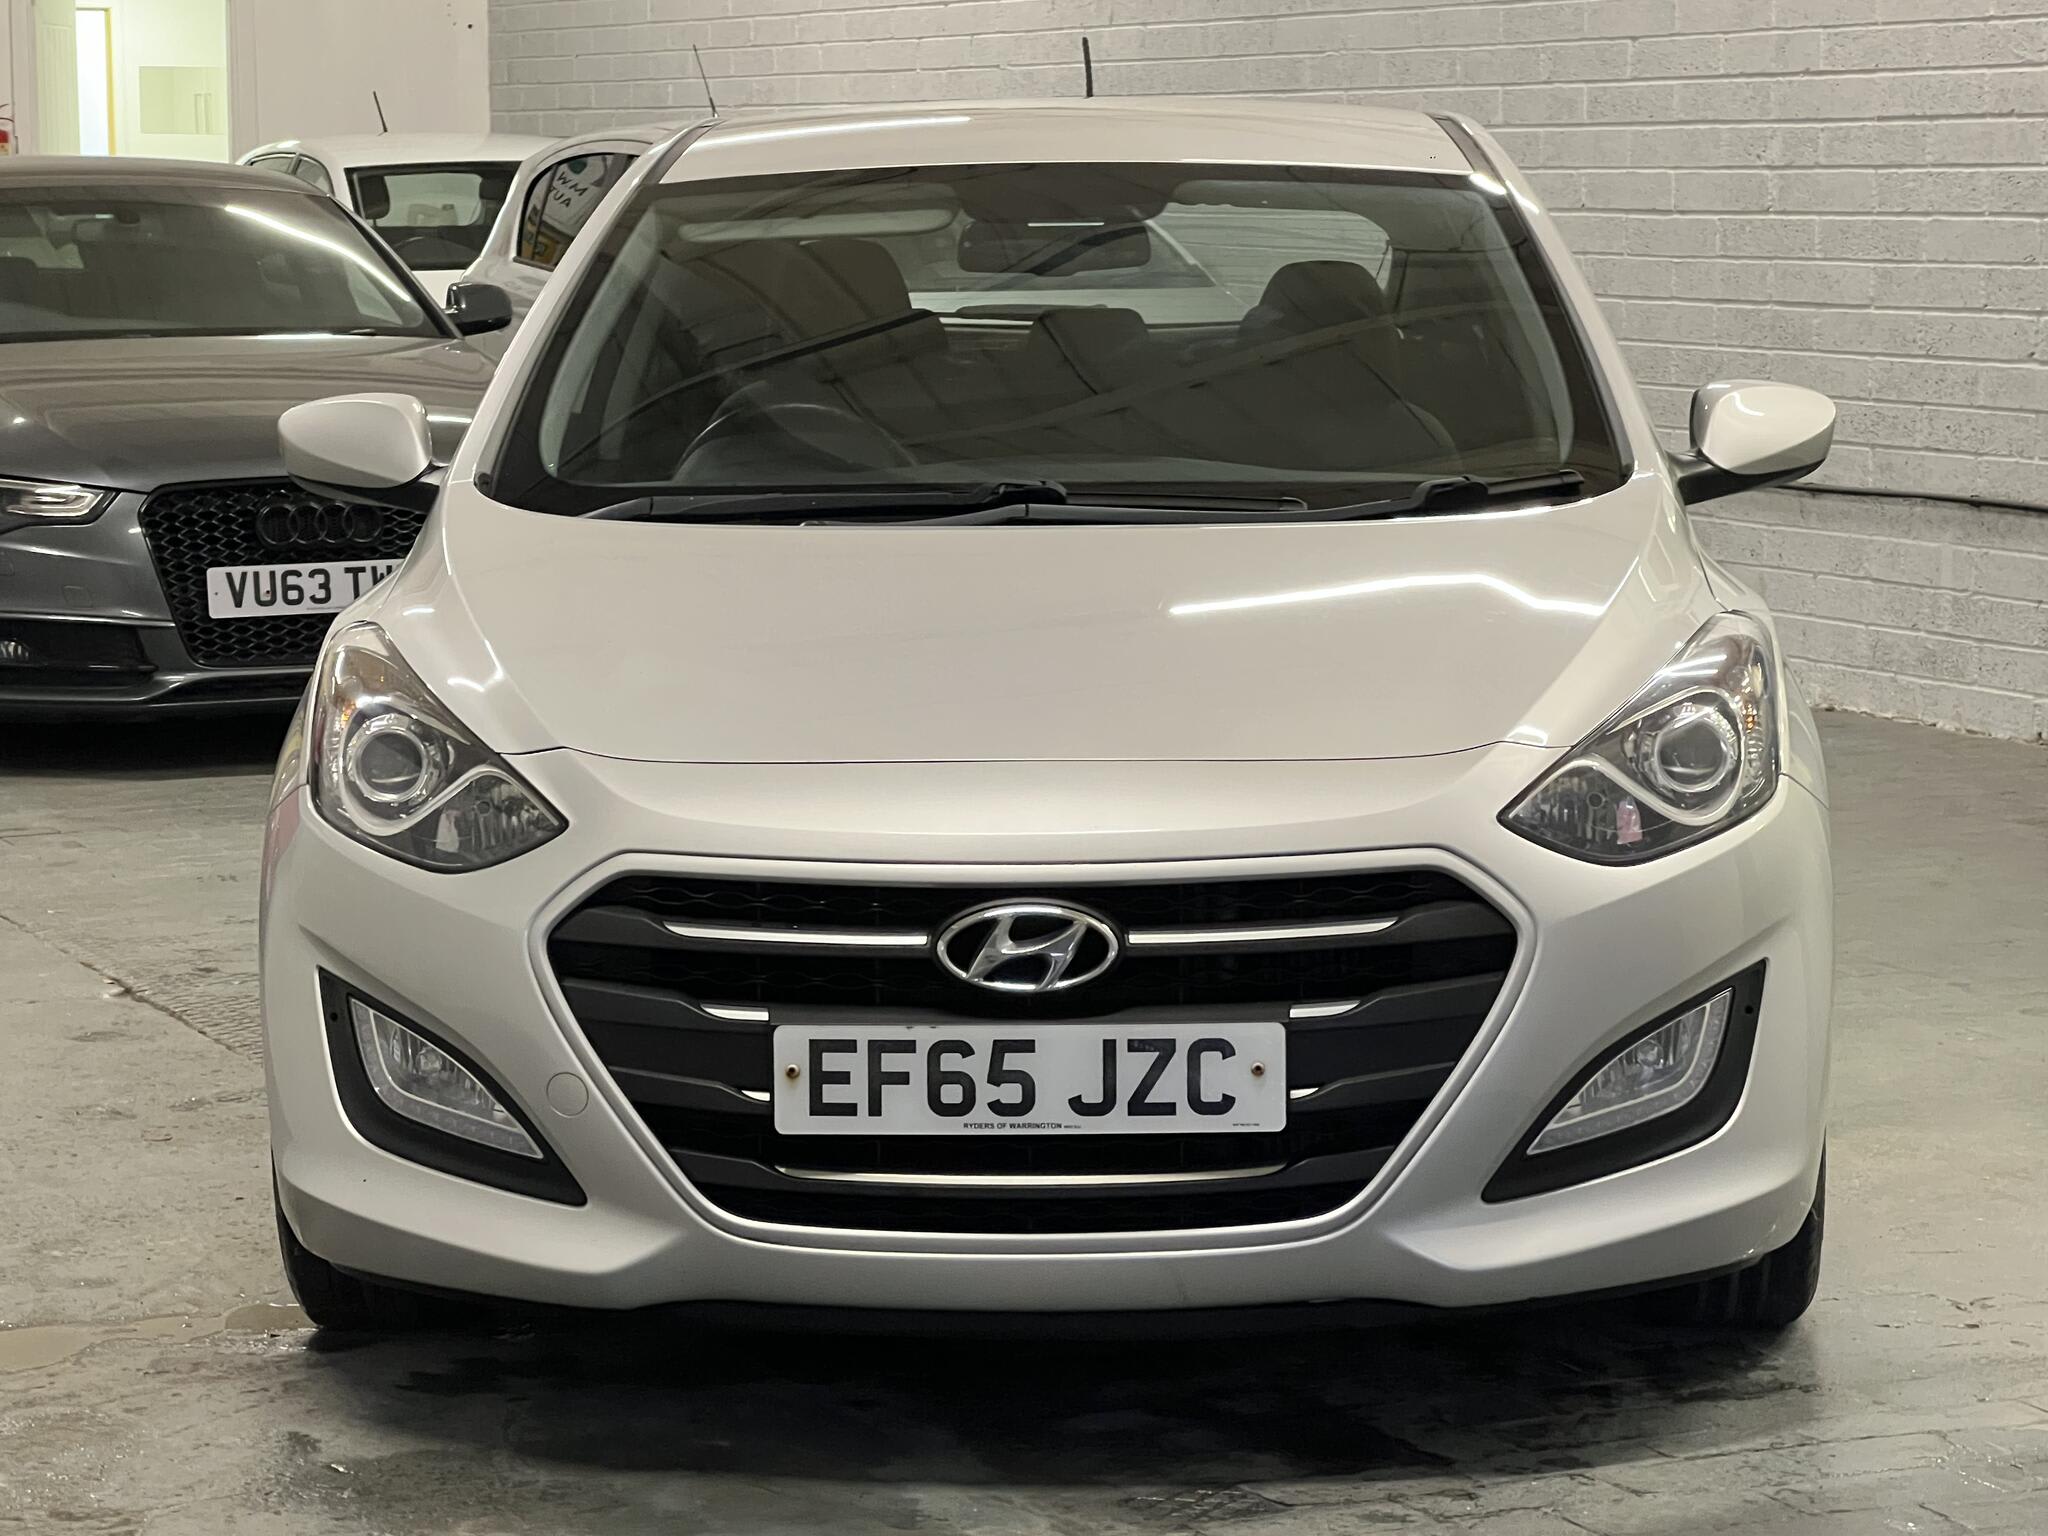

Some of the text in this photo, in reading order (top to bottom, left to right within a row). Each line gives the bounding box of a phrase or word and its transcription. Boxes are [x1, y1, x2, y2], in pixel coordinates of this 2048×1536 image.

[225, 568, 331, 608] VU63
[808, 1038, 1237, 1117] EF65 JZC
[963, 1122, 995, 1130] RYDERS
